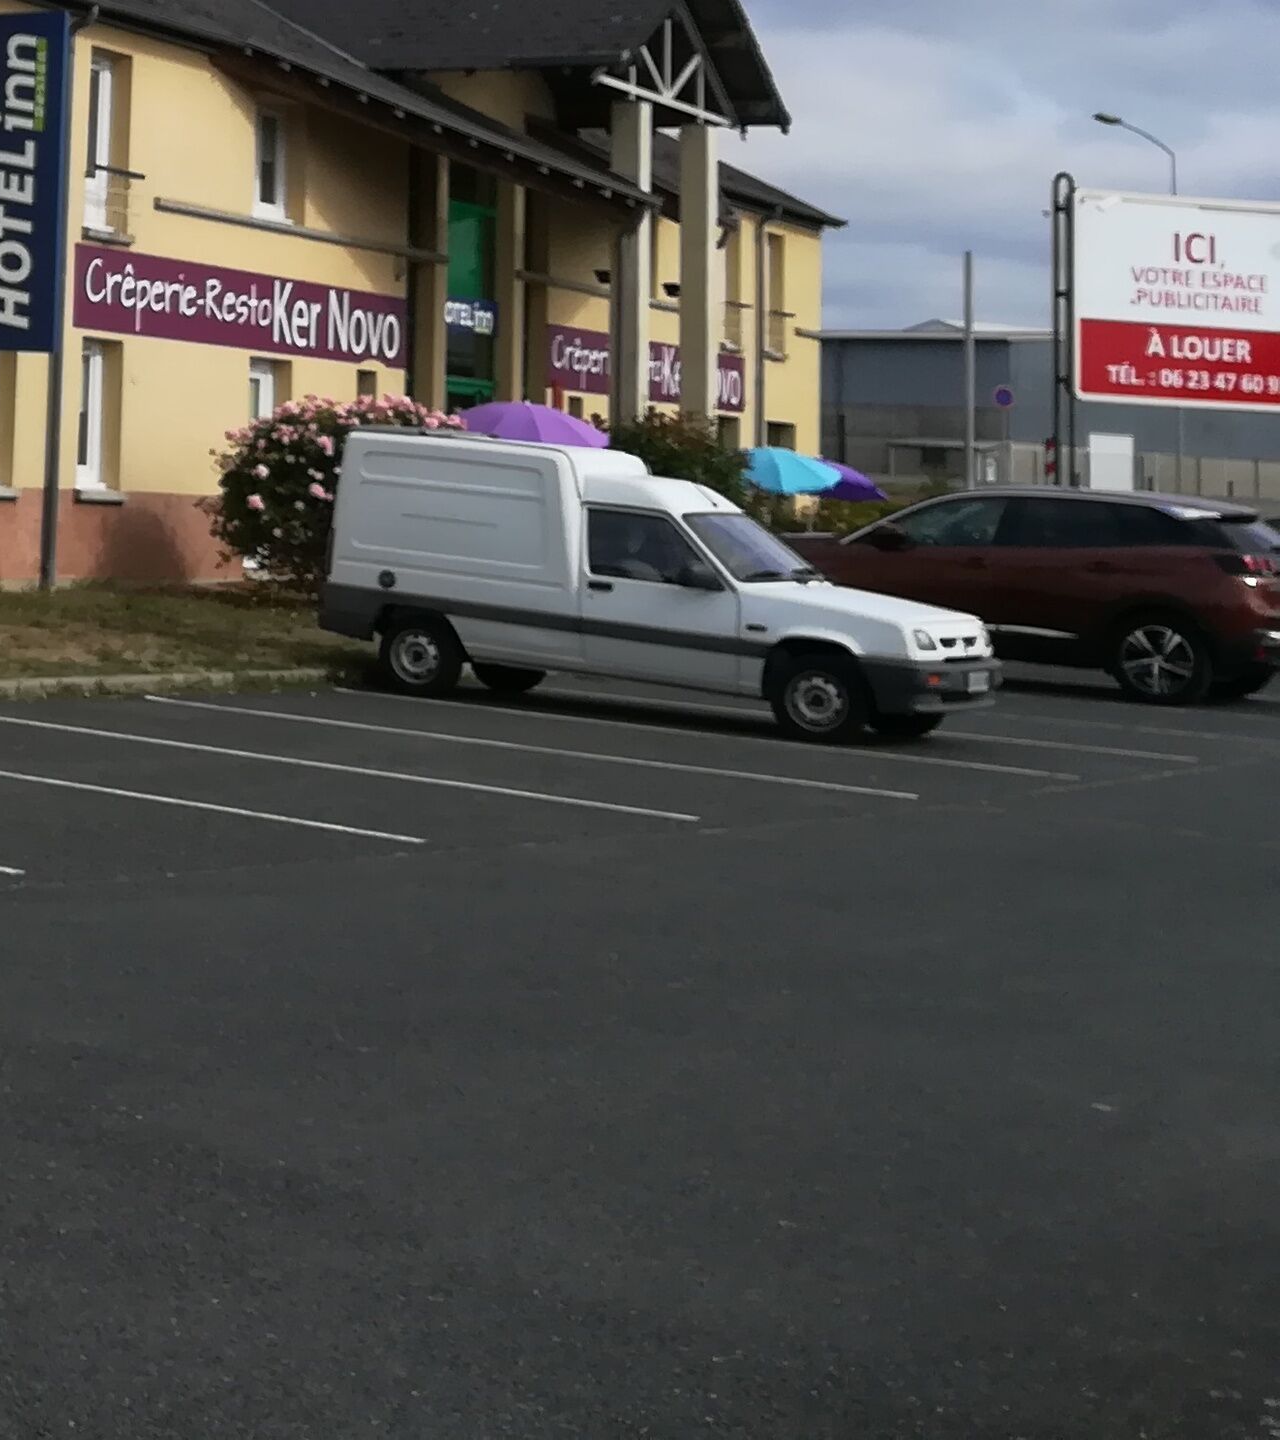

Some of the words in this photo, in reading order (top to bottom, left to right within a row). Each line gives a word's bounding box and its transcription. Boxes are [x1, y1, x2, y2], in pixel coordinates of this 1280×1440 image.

[1131, 266, 1192, 287] VOTRE
[1200, 273, 1268, 293] ESPACE
[272, 279, 322, 348] Ker
[328, 289, 401, 359] Novo
[1171, 336, 1252, 363] LOUER
[1213, 372, 1237, 392] 47
